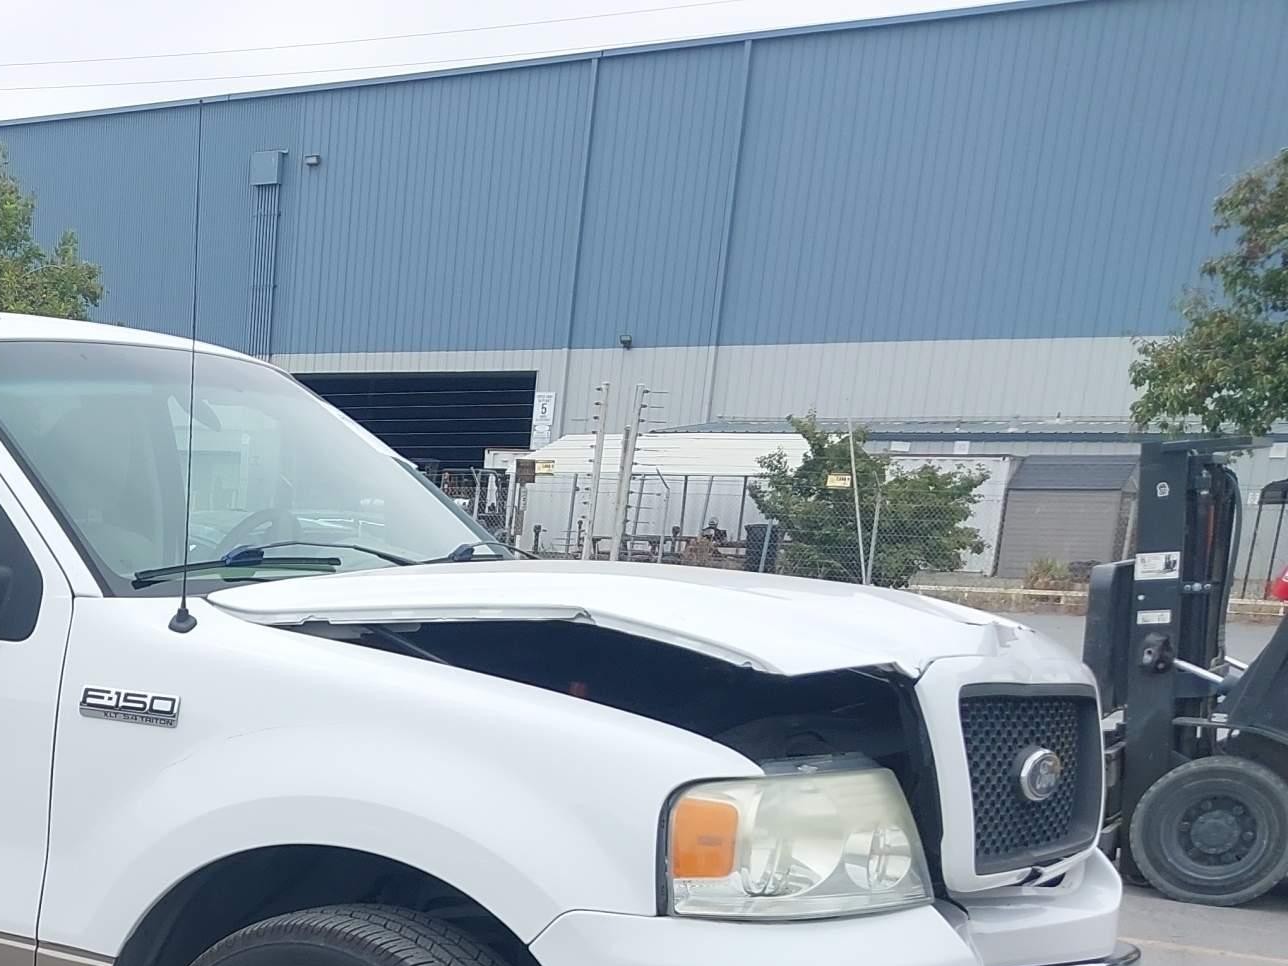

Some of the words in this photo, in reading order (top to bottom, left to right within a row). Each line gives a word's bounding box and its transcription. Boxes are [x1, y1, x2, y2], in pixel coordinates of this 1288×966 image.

[541, 403, 548, 415] 5
[103, 711, 118, 719] XLT
[140, 715, 174, 727] TRITON
